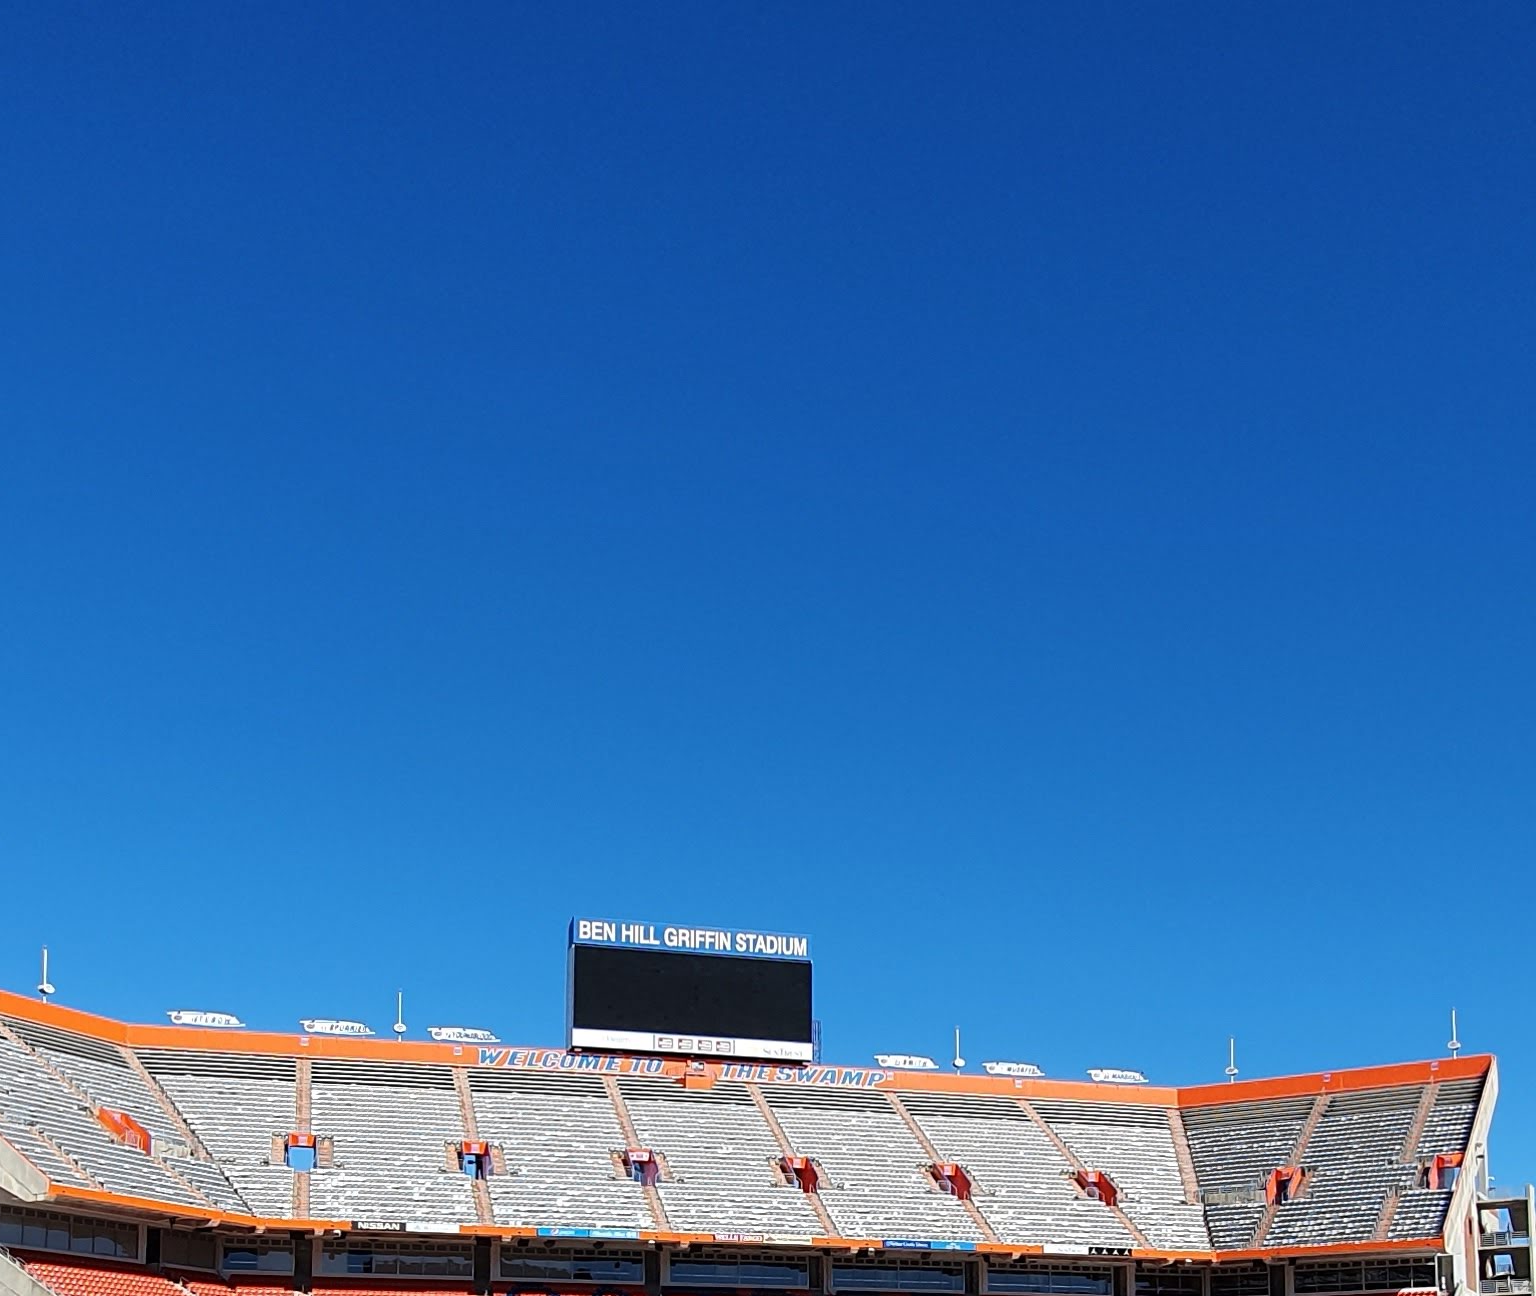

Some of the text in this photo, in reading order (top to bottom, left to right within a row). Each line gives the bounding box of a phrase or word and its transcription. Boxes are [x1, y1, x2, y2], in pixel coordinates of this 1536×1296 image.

[579, 920, 808, 957] BEN HILL GRIFFIN STADIUM
[478, 1047, 886, 1088] WELCOME TO THE SWAMP
[357, 1221, 400, 1231] NISSAN
